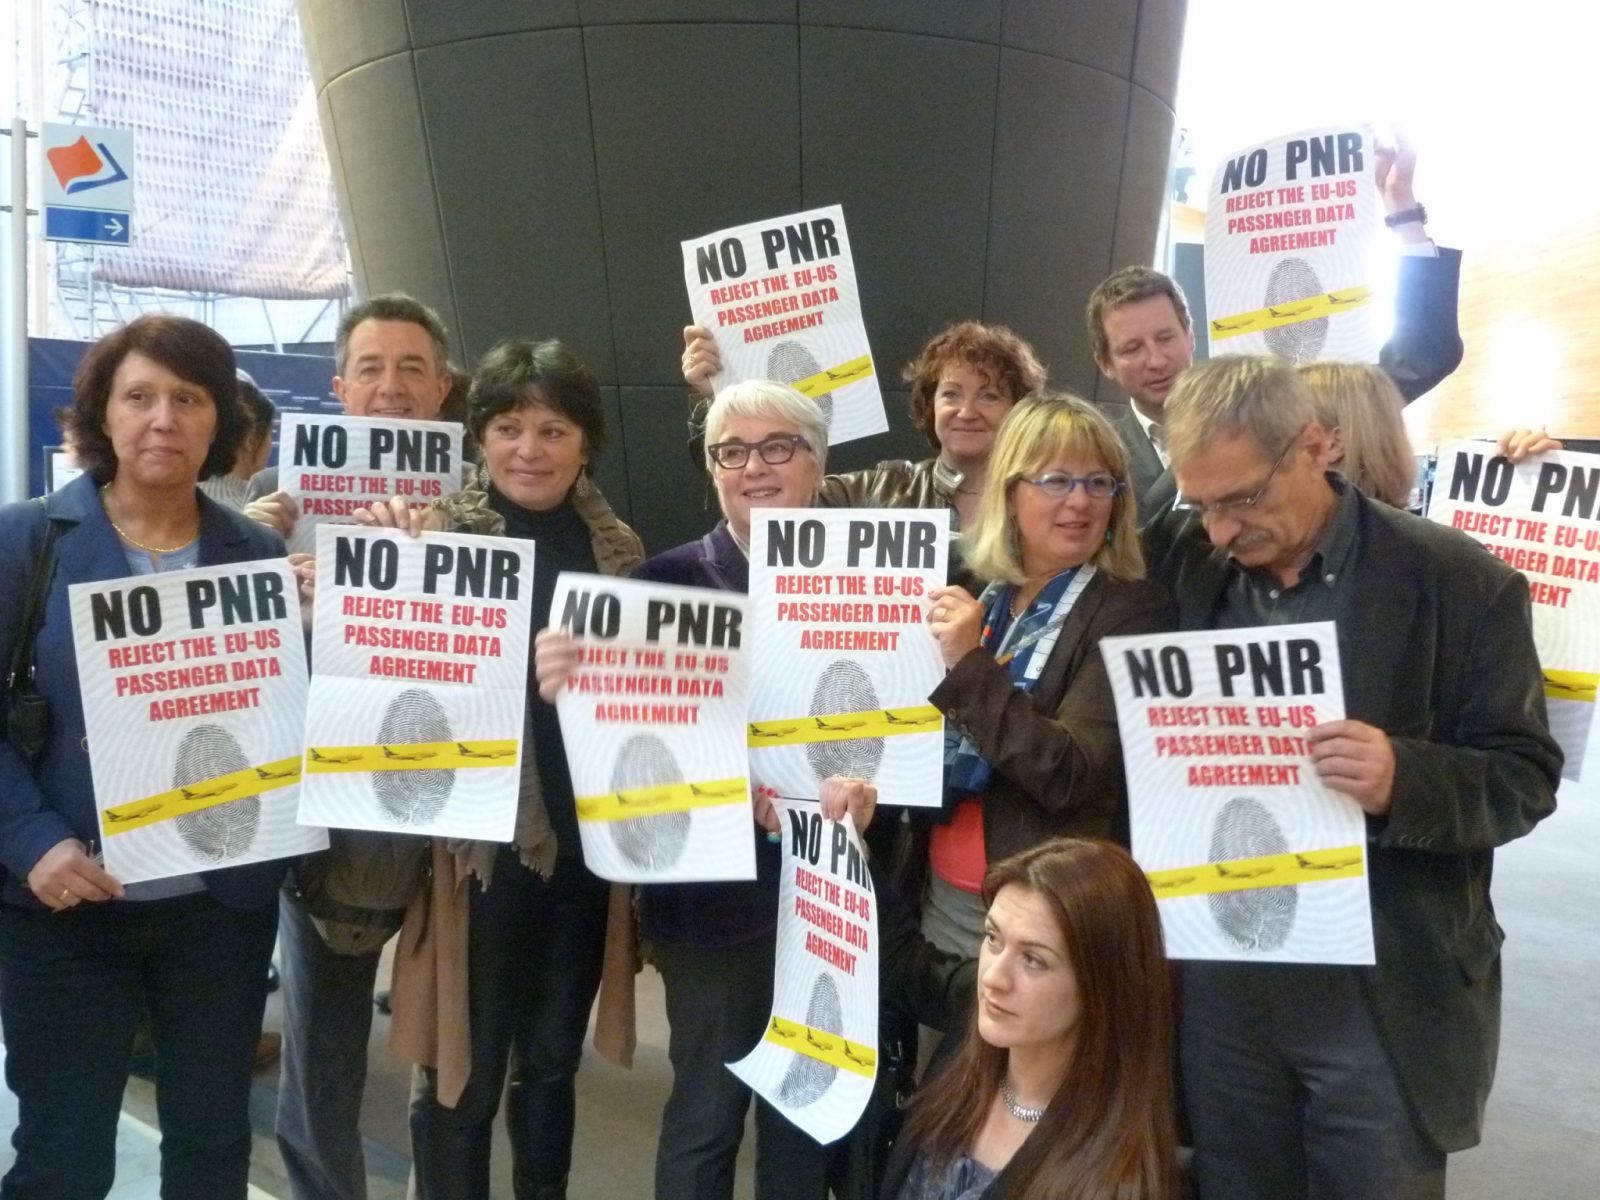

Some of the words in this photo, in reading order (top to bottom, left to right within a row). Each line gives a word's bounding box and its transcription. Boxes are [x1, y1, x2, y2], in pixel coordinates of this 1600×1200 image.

[1221, 148, 1267, 194] NO
[1286, 132, 1363, 181] PNR
[1226, 190, 1274, 213] REJECT
[1277, 186, 1304, 205] THE
[1311, 180, 1357, 201] EU-US
[1228, 209, 1312, 234] PASSENGER
[1316, 204, 1355, 223] DATA
[696, 238, 747, 285] NO
[761, 218, 840, 270] PNR
[1250, 229, 1336, 254] AGREEMENT
[710, 281, 759, 305] REJECT
[761, 275, 789, 294] THE
[794, 264, 838, 287] EU-US
[717, 296, 799, 327] PASSENGER
[801, 287, 839, 308] DATA
[743, 311, 824, 343] AGREEMENT
[294, 424, 347, 468] NO
[369, 428, 450, 473] PNR
[300, 474, 354, 492] REJECT
[360, 477, 388, 493] THE
[395, 479, 441, 496] EU-US
[1448, 451, 1514, 507] NO
[1531, 462, 1600, 521] PN
[767, 520, 825, 567] NO
[847, 521, 936, 568] PNR
[1452, 510, 1511, 536] REJECT
[1516, 519, 1547, 543] THE
[1554, 525, 1600, 552] EU-U
[334, 537, 399, 590] NO
[423, 544, 521, 600] PNR
[1485, 544, 1548, 574] ENGER
[1552, 556, 1599, 583] DATA
[776, 575, 832, 594] REJECT
[836, 576, 866, 595] THE
[874, 576, 924, 596] EU-US
[90, 586, 162, 641] NO
[185, 572, 287, 629] PNR
[342, 596, 405, 620] REJECT
[410, 601, 443, 623] THE
[452, 605, 507, 628] EU-US
[560, 589, 621, 639] NO
[646, 599, 743, 649] PNR
[778, 603, 873, 622] PASSENGER
[878, 604, 922, 623] DATA
[108, 641, 176, 669] REJECT
[180, 636, 217, 658] THE
[224, 629, 280, 653] EU-US
[344, 625, 448, 651] PASSENGER
[453, 634, 501, 657] DATA
[578, 647, 628, 666] EJECT
[635, 650, 665, 669] THE
[675, 653, 728, 673] EU-US
[800, 630, 900, 651] AGREEMENT
[116, 664, 227, 697] PASSENGER
[232, 657, 281, 681] DATA
[370, 656, 476, 684] AGREEMENT
[567, 675, 672, 696] PASSENGER
[677, 679, 724, 698] DATA
[1125, 646, 1193, 698] NO
[1215, 639, 1325, 697] PNR
[150, 688, 260, 721] AGREEMENT
[595, 703, 699, 724] AGREEMENT
[1147, 706, 1211, 728] REJECT
[1213, 707, 1249, 726] THE
[1258, 705, 1316, 728] EU-US
[1156, 736, 1264, 757] PASSENGER
[1188, 765, 1299, 787] AGREEMENT
[788, 809, 822, 865] NO
[796, 867, 823, 898] REJECT
[825, 880, 840, 906] THE
[844, 890, 870, 922] EU-US
[795, 896, 843, 938] PASSENGER
[845, 920, 868, 952] DATA
[805, 932, 857, 976] AGREEMENT
